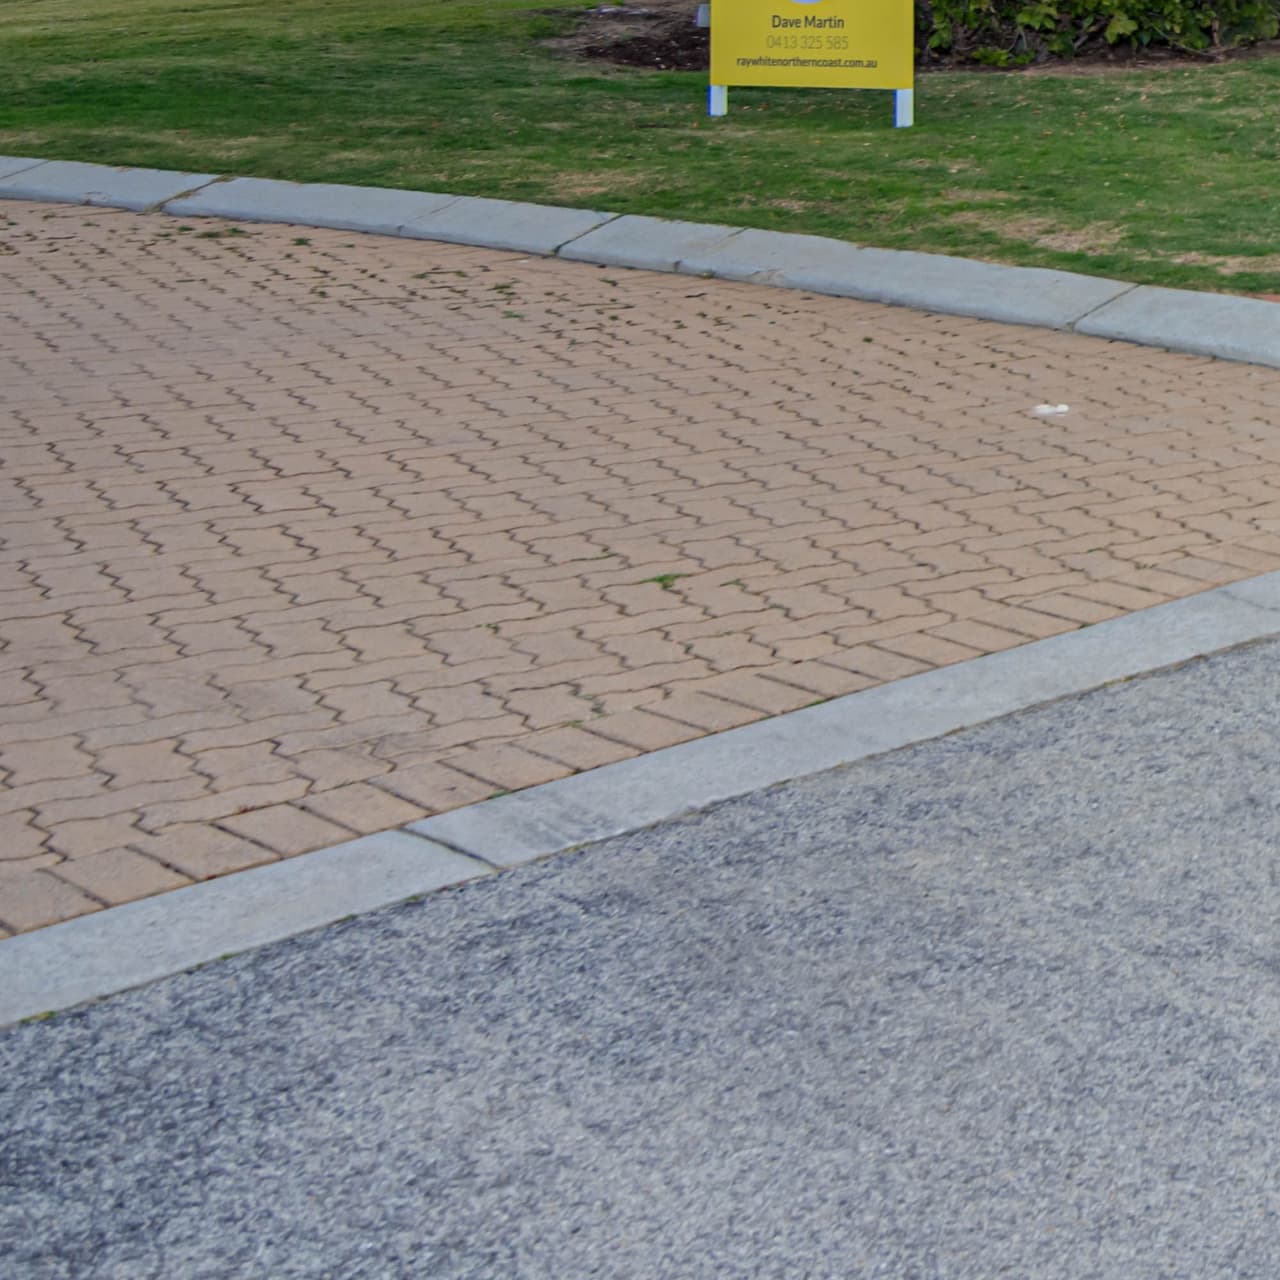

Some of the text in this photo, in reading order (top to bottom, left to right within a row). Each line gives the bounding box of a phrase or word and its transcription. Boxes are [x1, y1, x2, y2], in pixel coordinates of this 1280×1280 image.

[771, 14, 845, 29] Dave Martin
[766, 34, 798, 49] 0413
